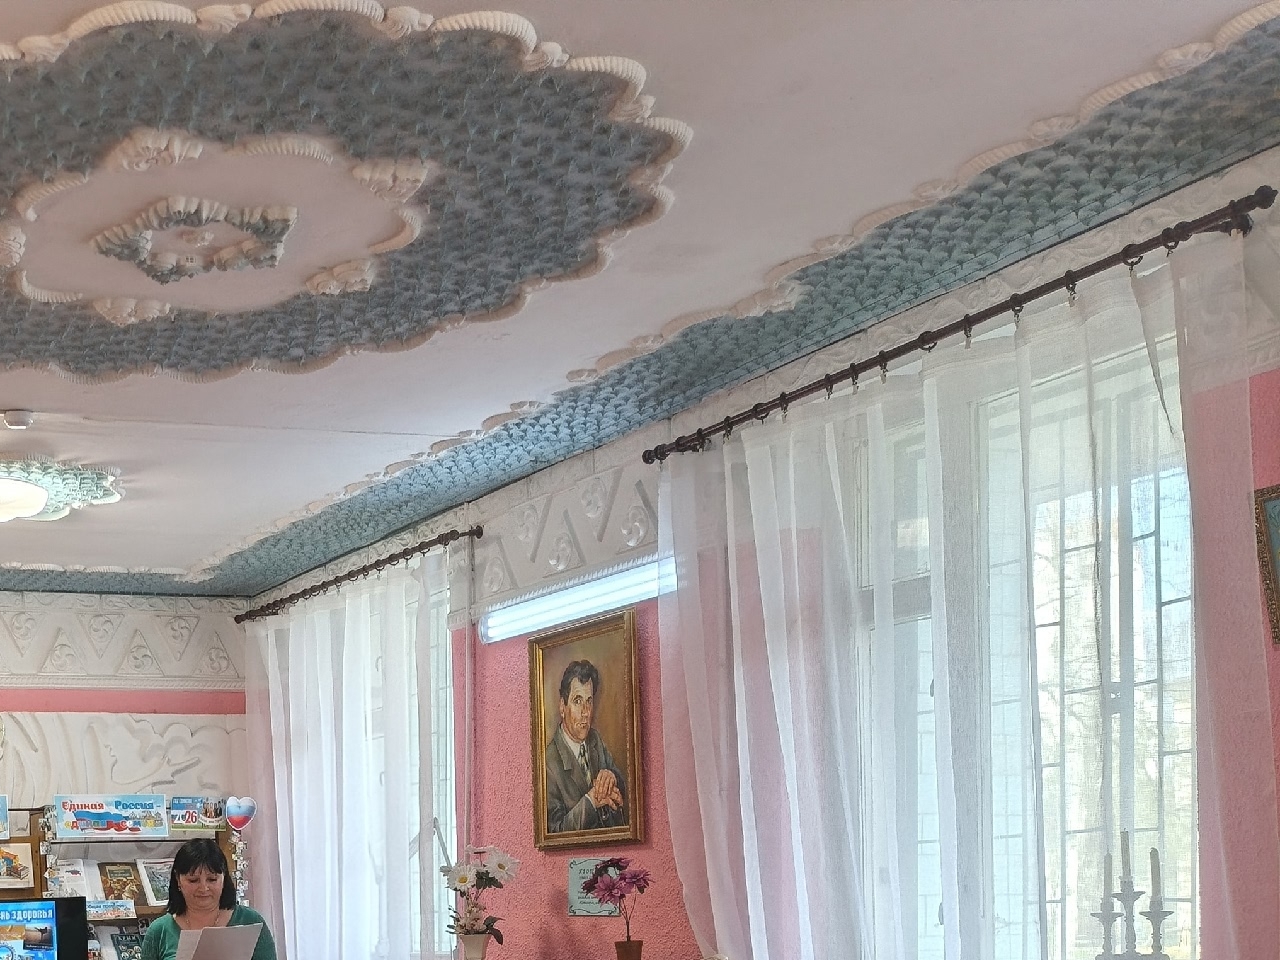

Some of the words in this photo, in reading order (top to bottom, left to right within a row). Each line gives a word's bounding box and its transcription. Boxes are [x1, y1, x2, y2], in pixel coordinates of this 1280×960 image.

[61, 800, 105, 812] Единая
[114, 800, 154, 810] Россия
[11, 908, 53, 921] здоровья
